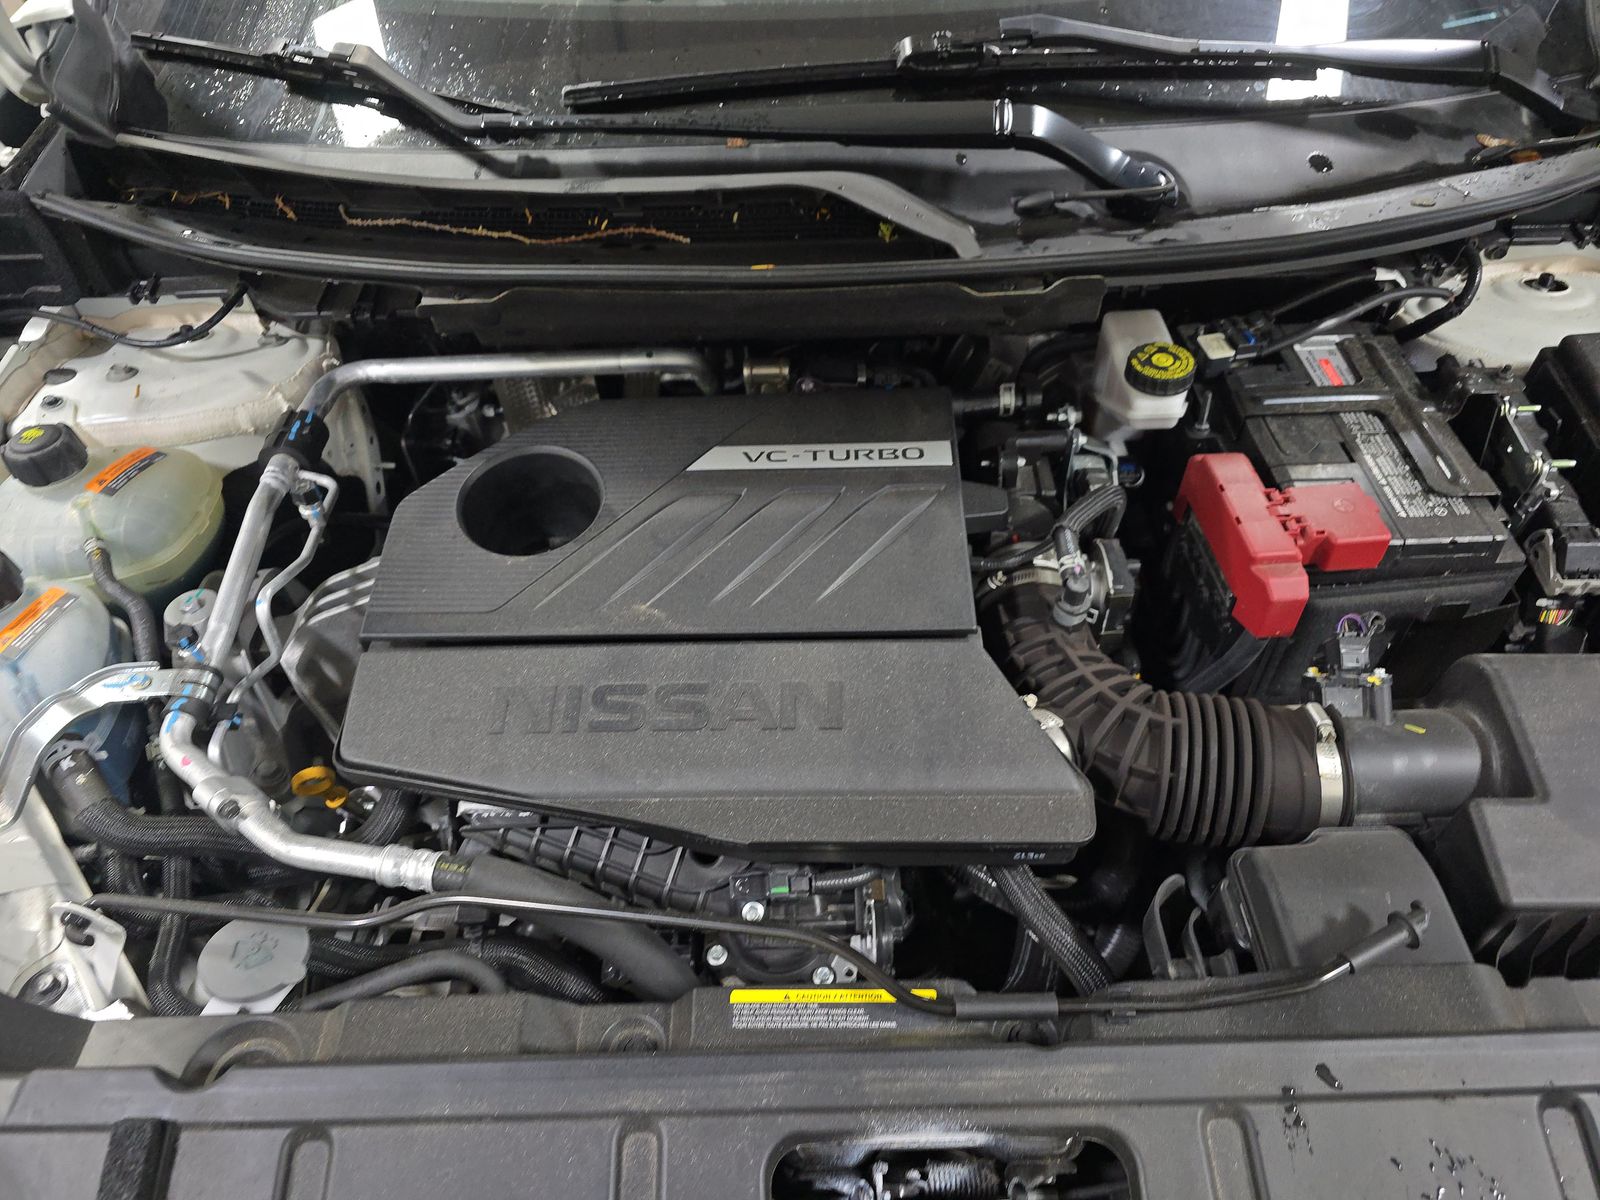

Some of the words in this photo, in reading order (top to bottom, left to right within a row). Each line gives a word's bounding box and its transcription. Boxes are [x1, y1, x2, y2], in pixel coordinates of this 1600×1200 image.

[742, 447, 925, 463] VC-TURBO
[489, 681, 844, 734] NISSAN
[796, 993, 831, 1001] CAUTION
